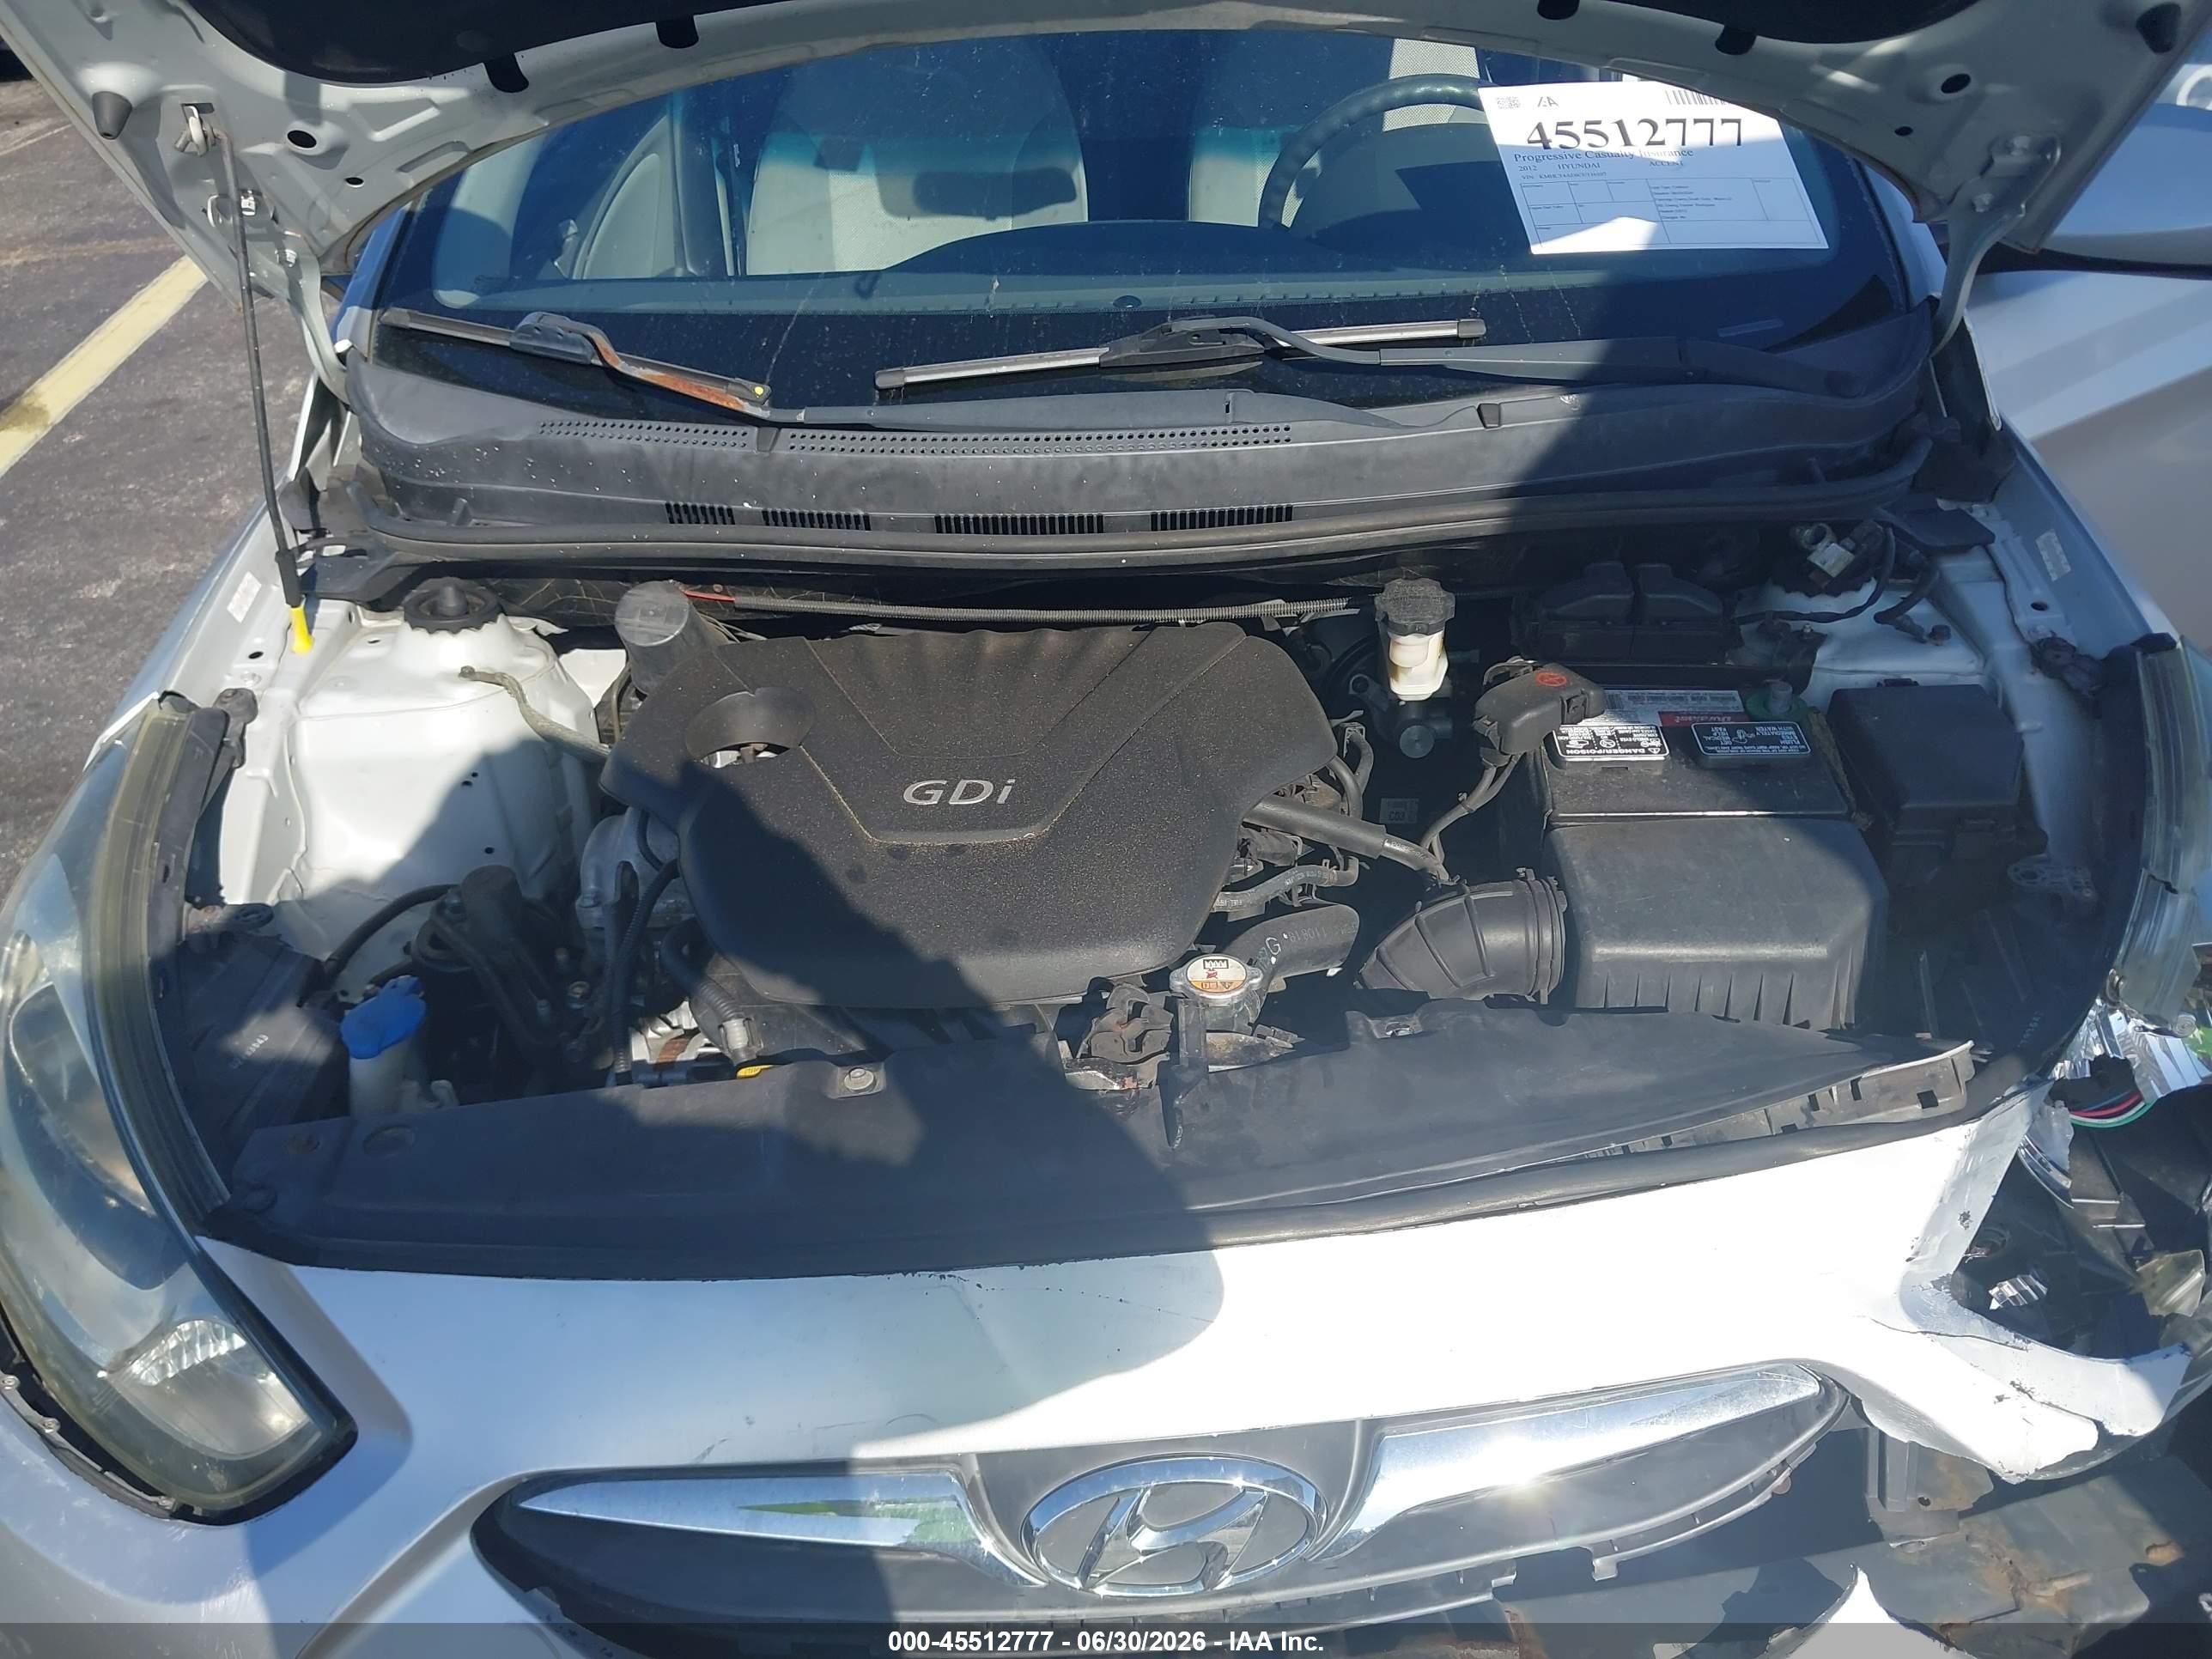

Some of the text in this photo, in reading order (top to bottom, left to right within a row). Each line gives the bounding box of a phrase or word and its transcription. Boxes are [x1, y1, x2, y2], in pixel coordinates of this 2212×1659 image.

[1527, 118, 1742, 150] 45512777
[1514, 149, 1694, 163] Progressive Casualty Insurance
[1557, 161, 1601, 170] HYUNDAI
[903, 779, 1016, 805] GDi
